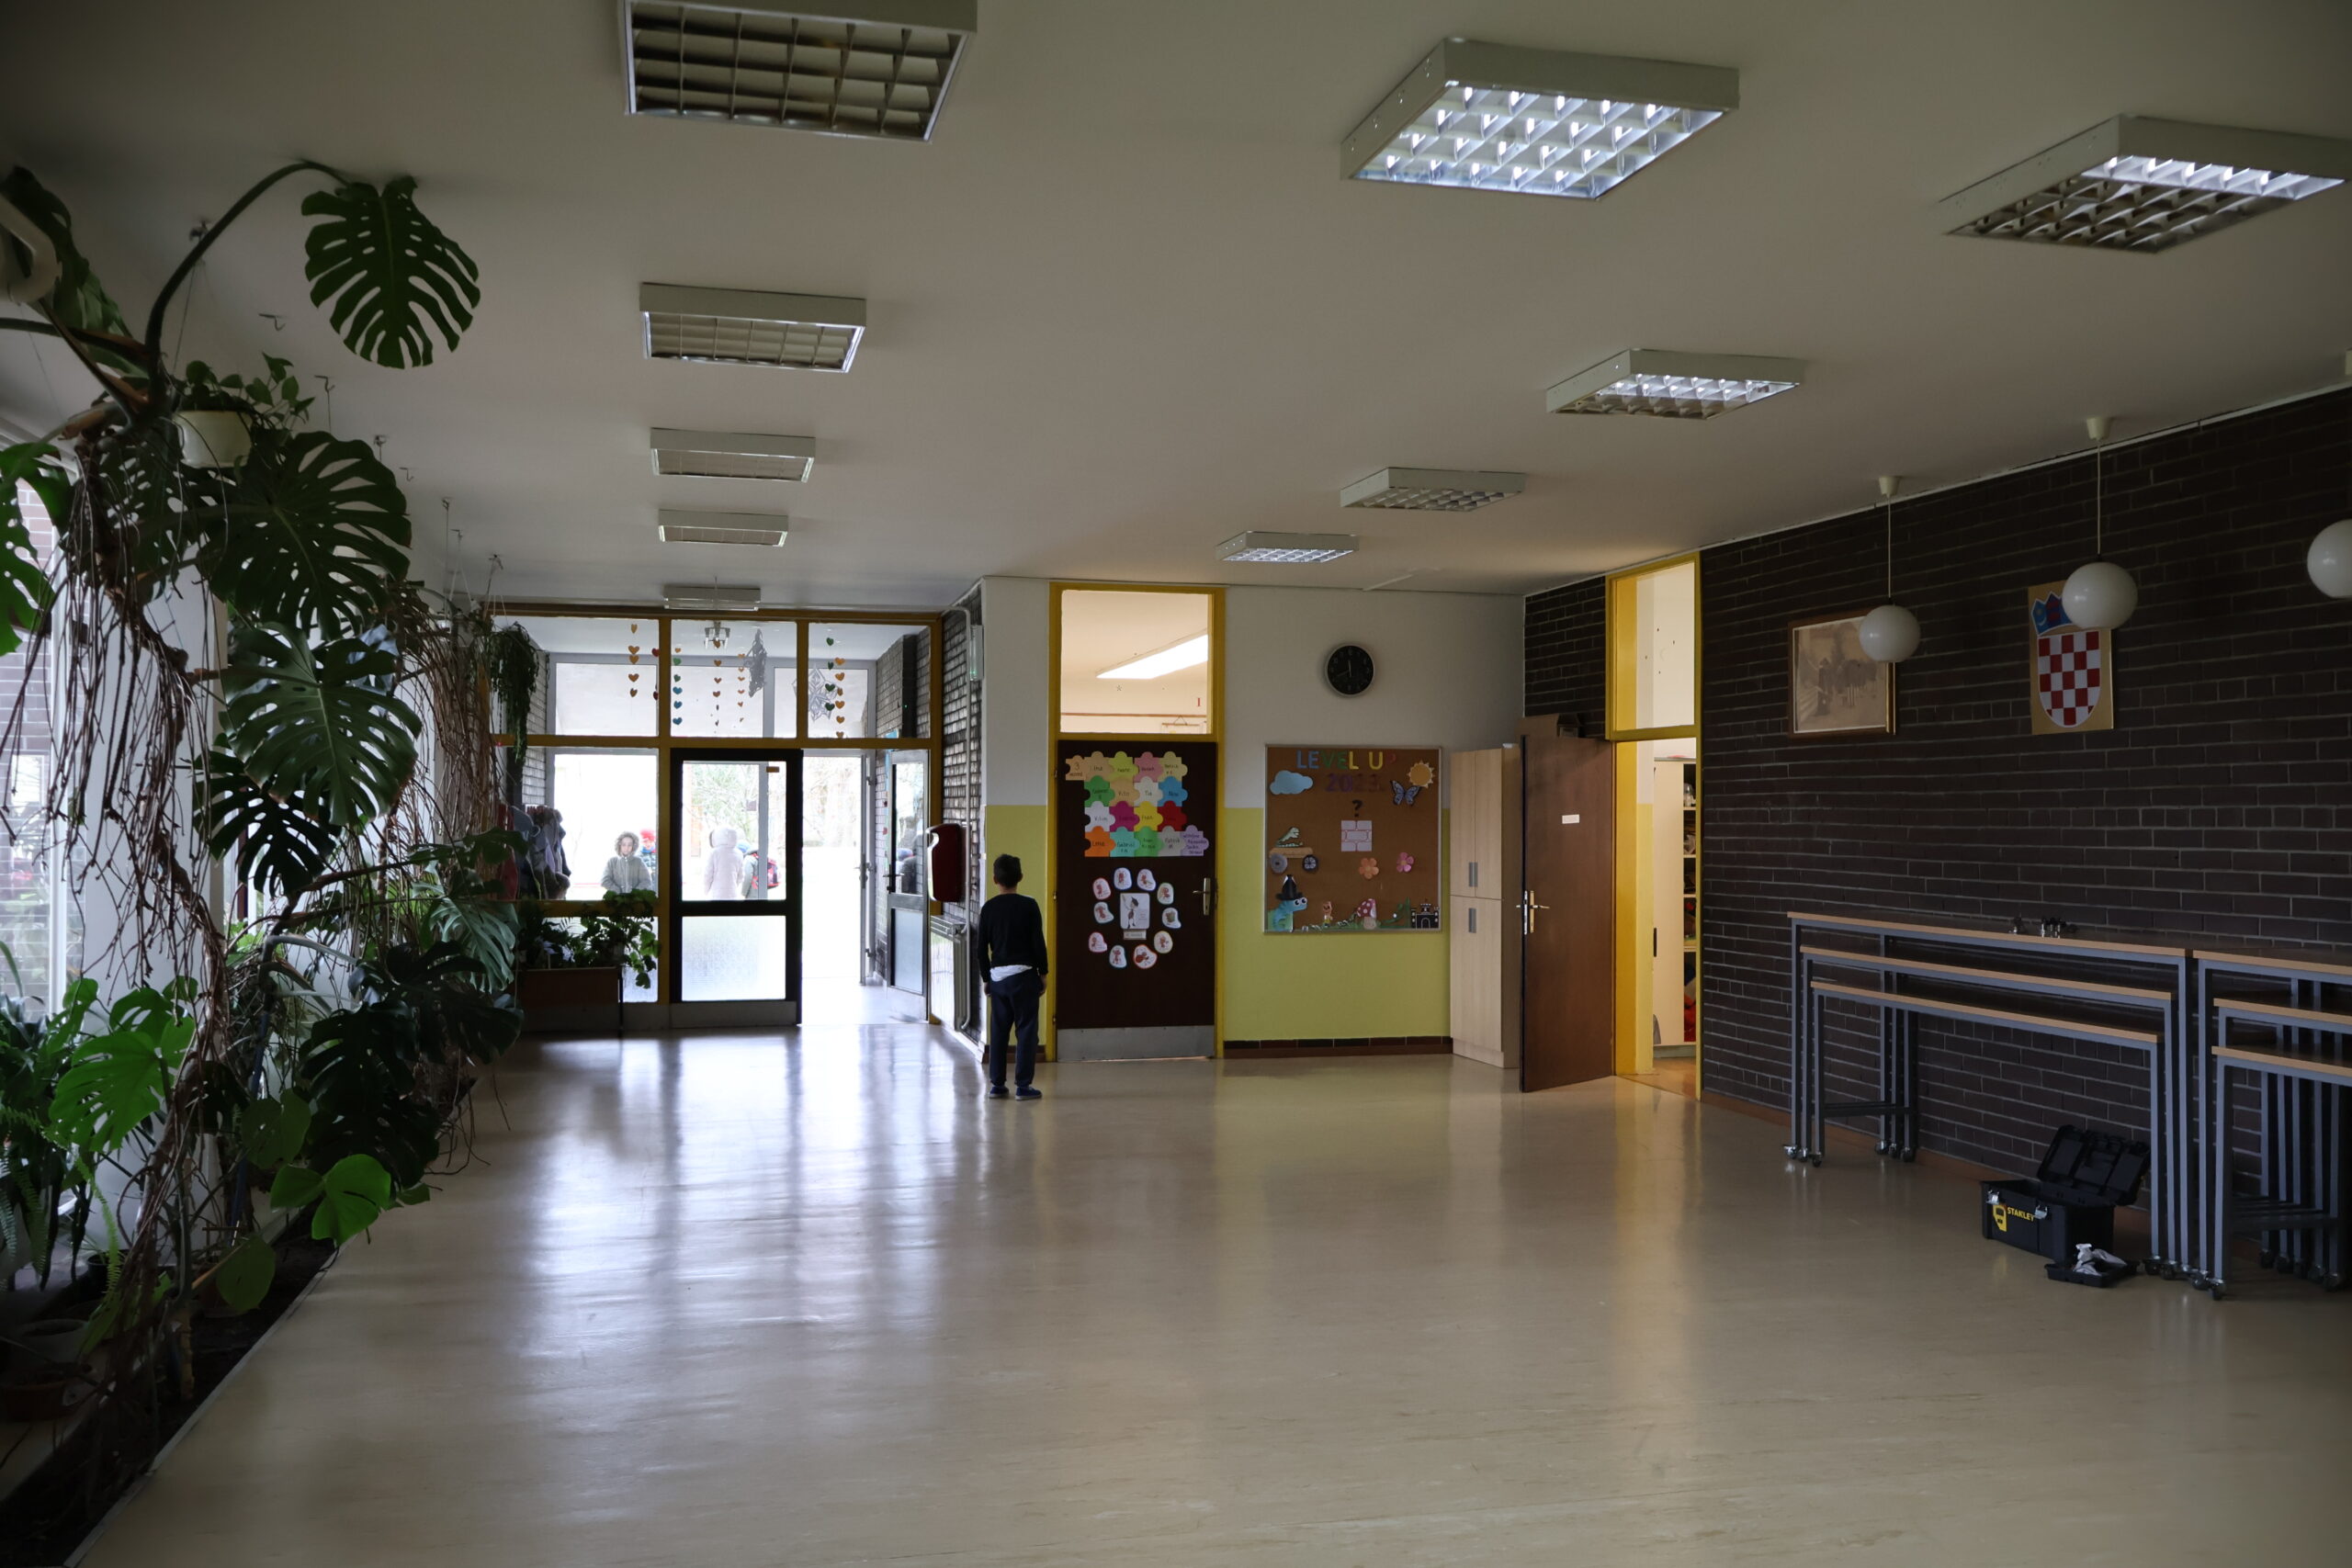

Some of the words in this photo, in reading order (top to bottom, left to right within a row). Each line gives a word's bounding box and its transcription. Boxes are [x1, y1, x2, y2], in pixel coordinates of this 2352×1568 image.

[1074, 762, 1080, 771] 3
[1296, 750, 1360, 770] LEVEL
[1368, 750, 1396, 770] UP
[1351, 799, 1363, 818] ?
[2007, 1206, 2035, 1223] STANLEY
